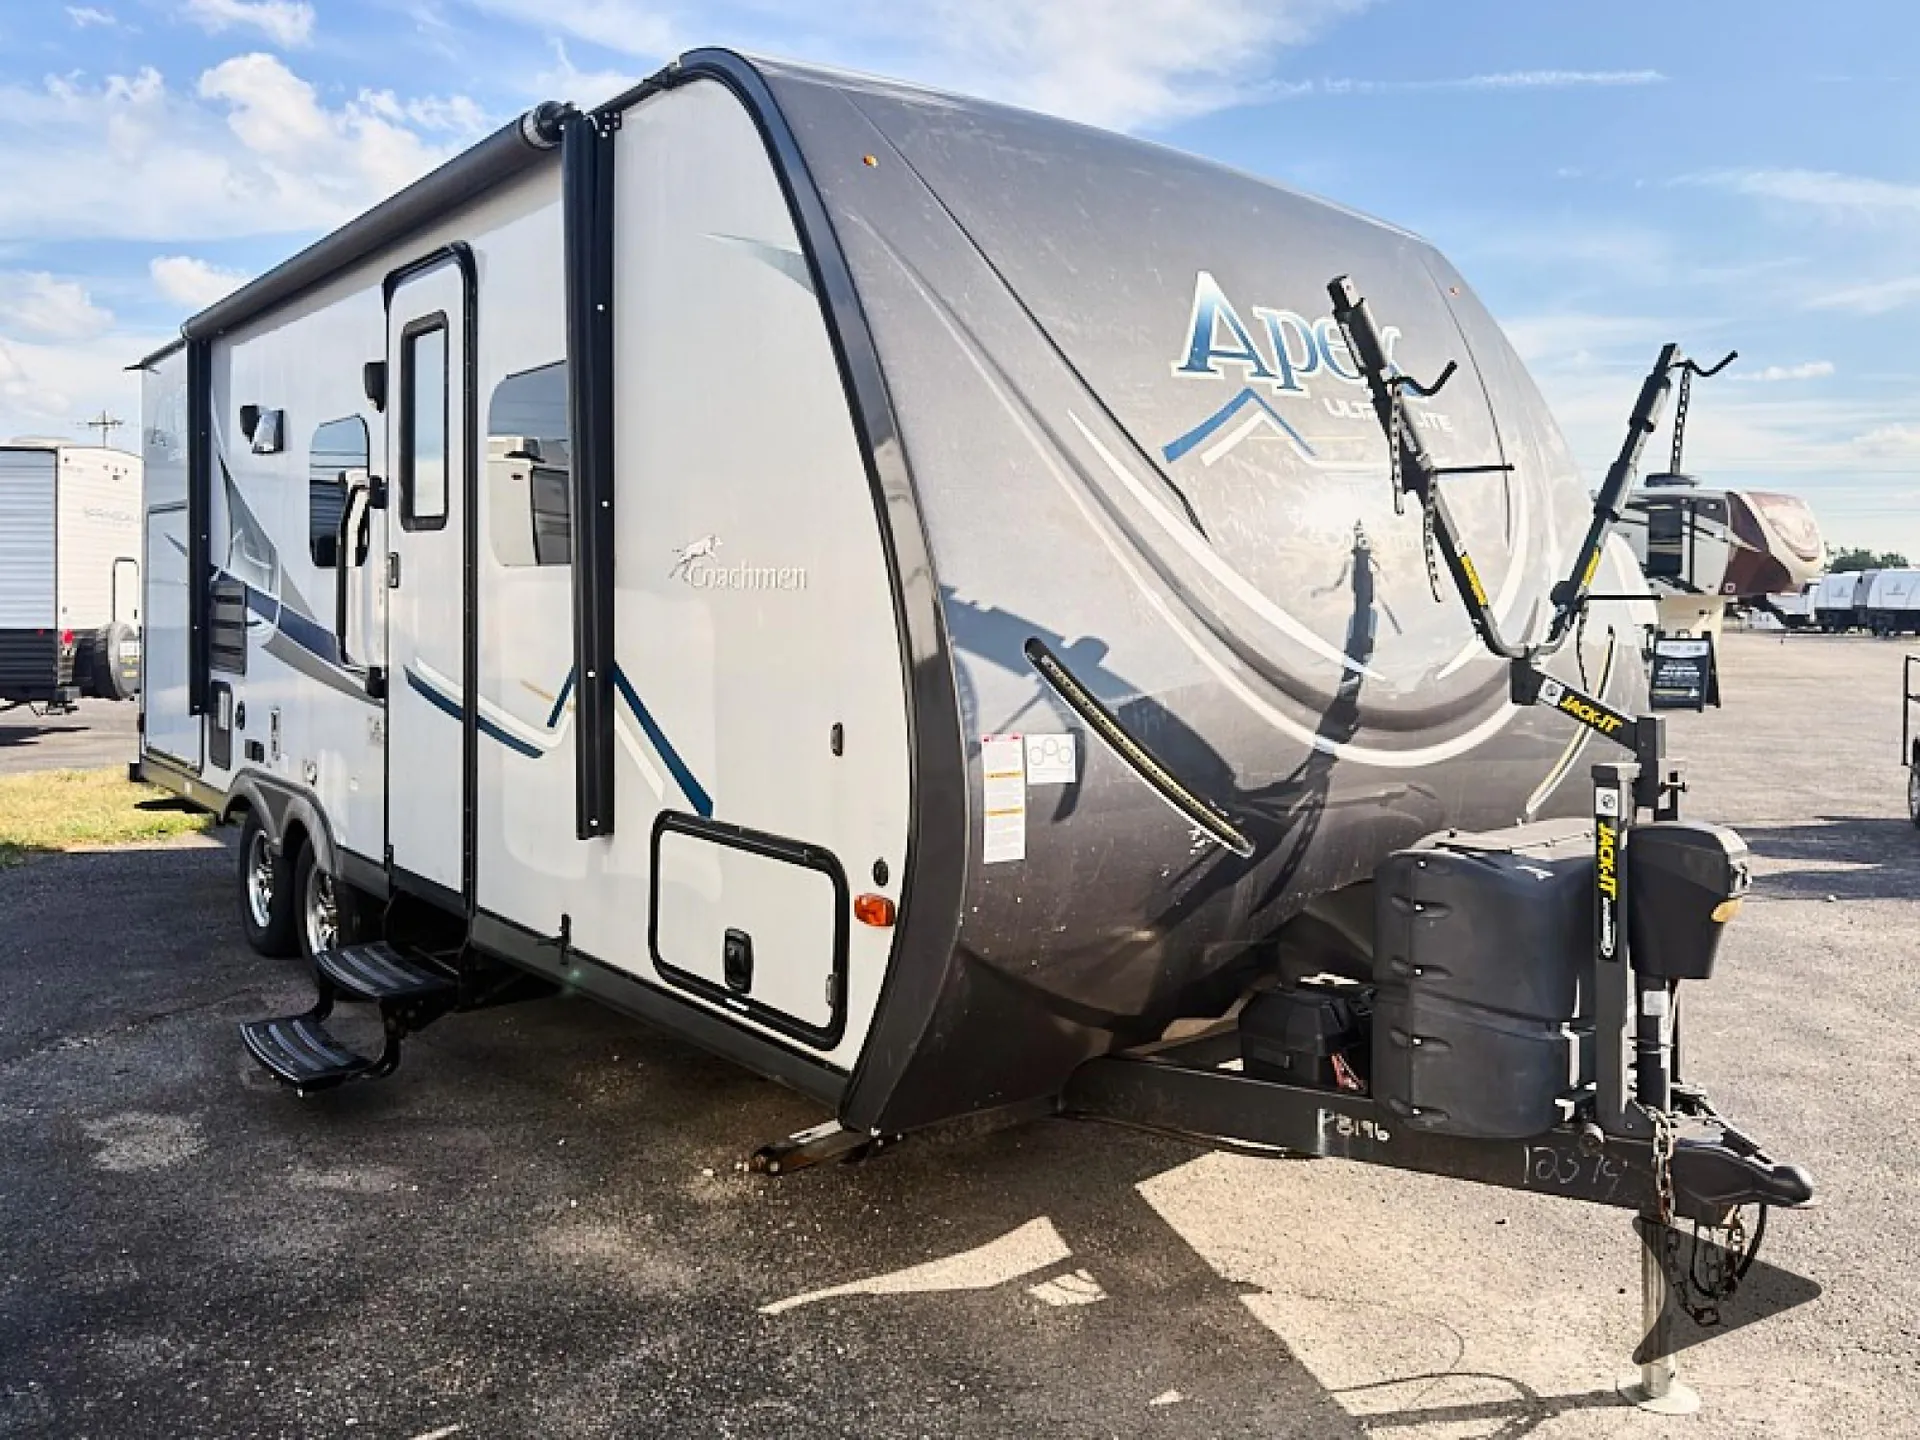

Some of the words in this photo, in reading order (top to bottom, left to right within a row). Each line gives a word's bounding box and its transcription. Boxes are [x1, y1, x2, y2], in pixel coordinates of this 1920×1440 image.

[690, 561, 807, 590] Coachmen
[1559, 695, 1623, 732] JACK-IT
[1598, 822, 1618, 901] JACK-IT
